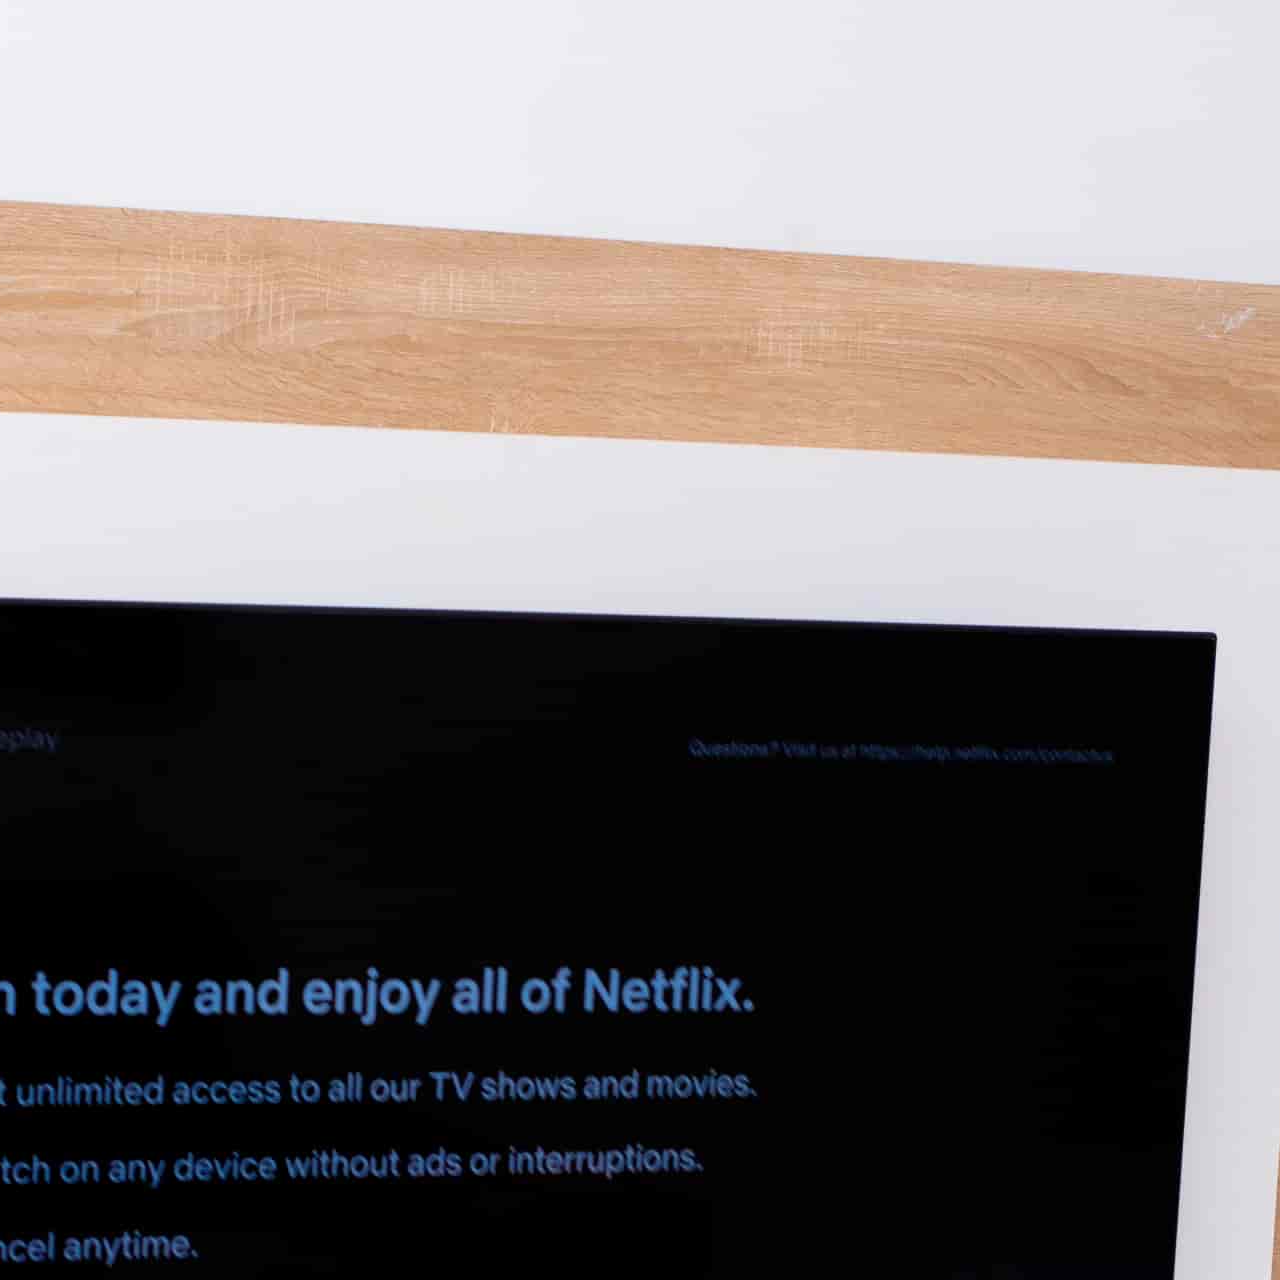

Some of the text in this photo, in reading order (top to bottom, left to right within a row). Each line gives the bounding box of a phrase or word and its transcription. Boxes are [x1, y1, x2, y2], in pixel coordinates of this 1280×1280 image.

[687, 735, 780, 759] Questions?
[31, 967, 182, 1027] today
[194, 967, 289, 1016] and
[302, 967, 441, 1026] enjoy
[451, 967, 508, 1014] all
[520, 967, 572, 1014] of
[583, 966, 754, 1013] Netflix.
[16, 1075, 165, 1107] unlimited
[172, 1079, 282, 1105] access
[289, 1073, 321, 1103] to
[327, 1071, 363, 1103] all
[369, 1078, 422, 1103] our
[429, 1071, 475, 1101] TV
[480, 1071, 577, 1101] shows
[583, 1069, 640, 1100] and
[646, 1069, 757, 1098] movies.
[59, 1160, 101, 1185] on
[107, 1158, 166, 1190] any
[173, 1151, 278, 1182] device
[285, 1147, 400, 1179] without
[407, 1146, 463, 1177] ads
[469, 1151, 501, 1176] or
[508, 1142, 704, 1179] interruptions.
[63, 1229, 199, 1268] anytime.
